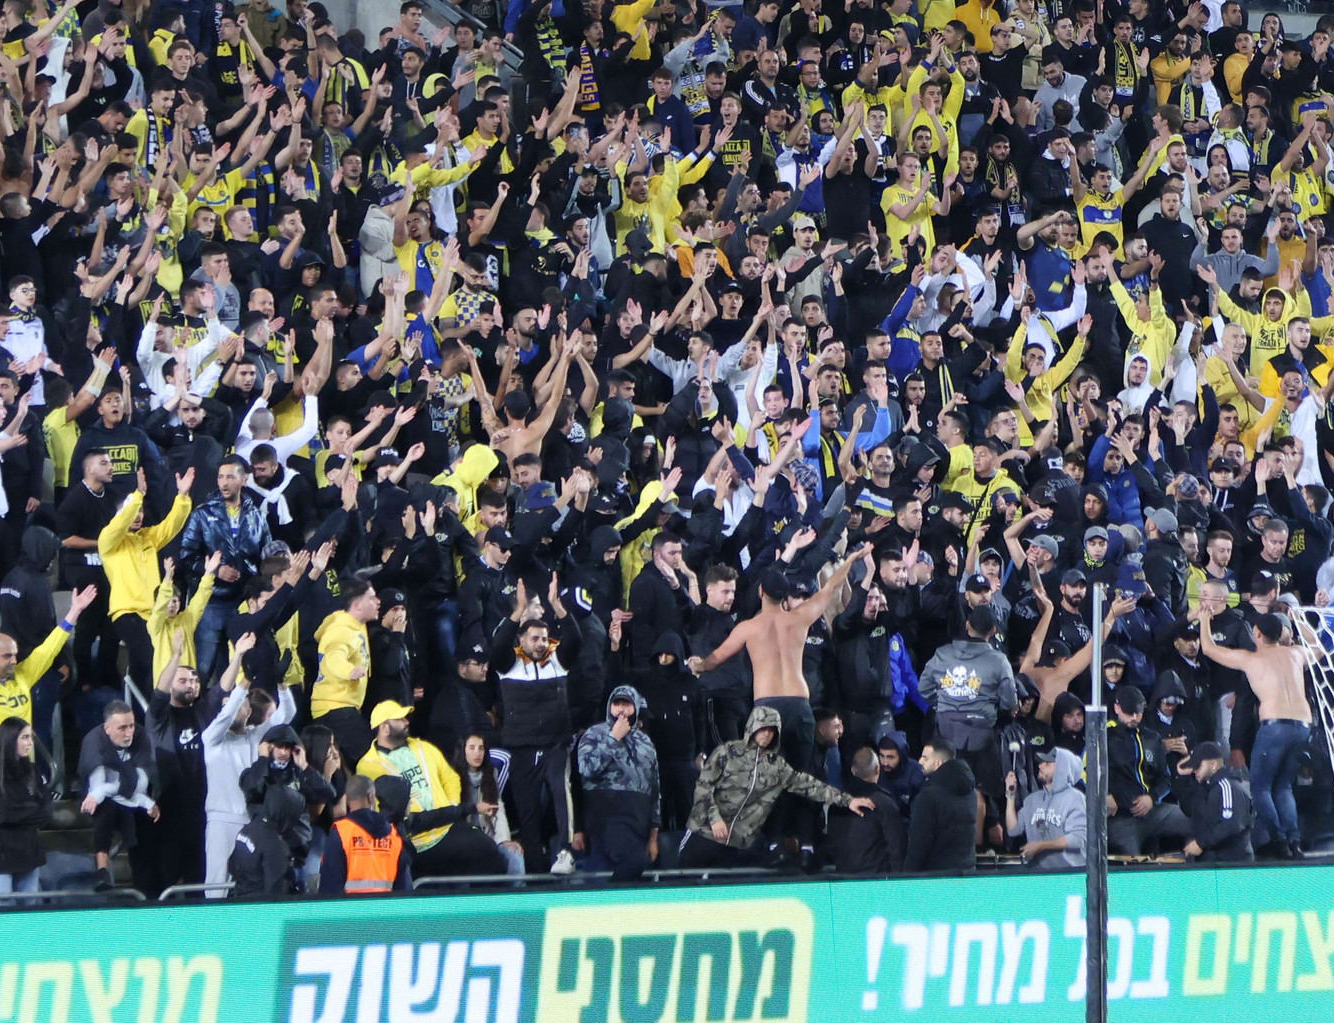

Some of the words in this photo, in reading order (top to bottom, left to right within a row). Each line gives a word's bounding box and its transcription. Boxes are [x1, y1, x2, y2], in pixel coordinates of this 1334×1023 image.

[108, 446, 137, 462] CCABI
[351, 835, 390, 850] PRTECT
[288, 939, 525, 1023] השוק
[558, 929, 795, 1023] מחסני
[862, 916, 1050, 1010] מחיר!
[1065, 895, 1170, 1001] בכל
